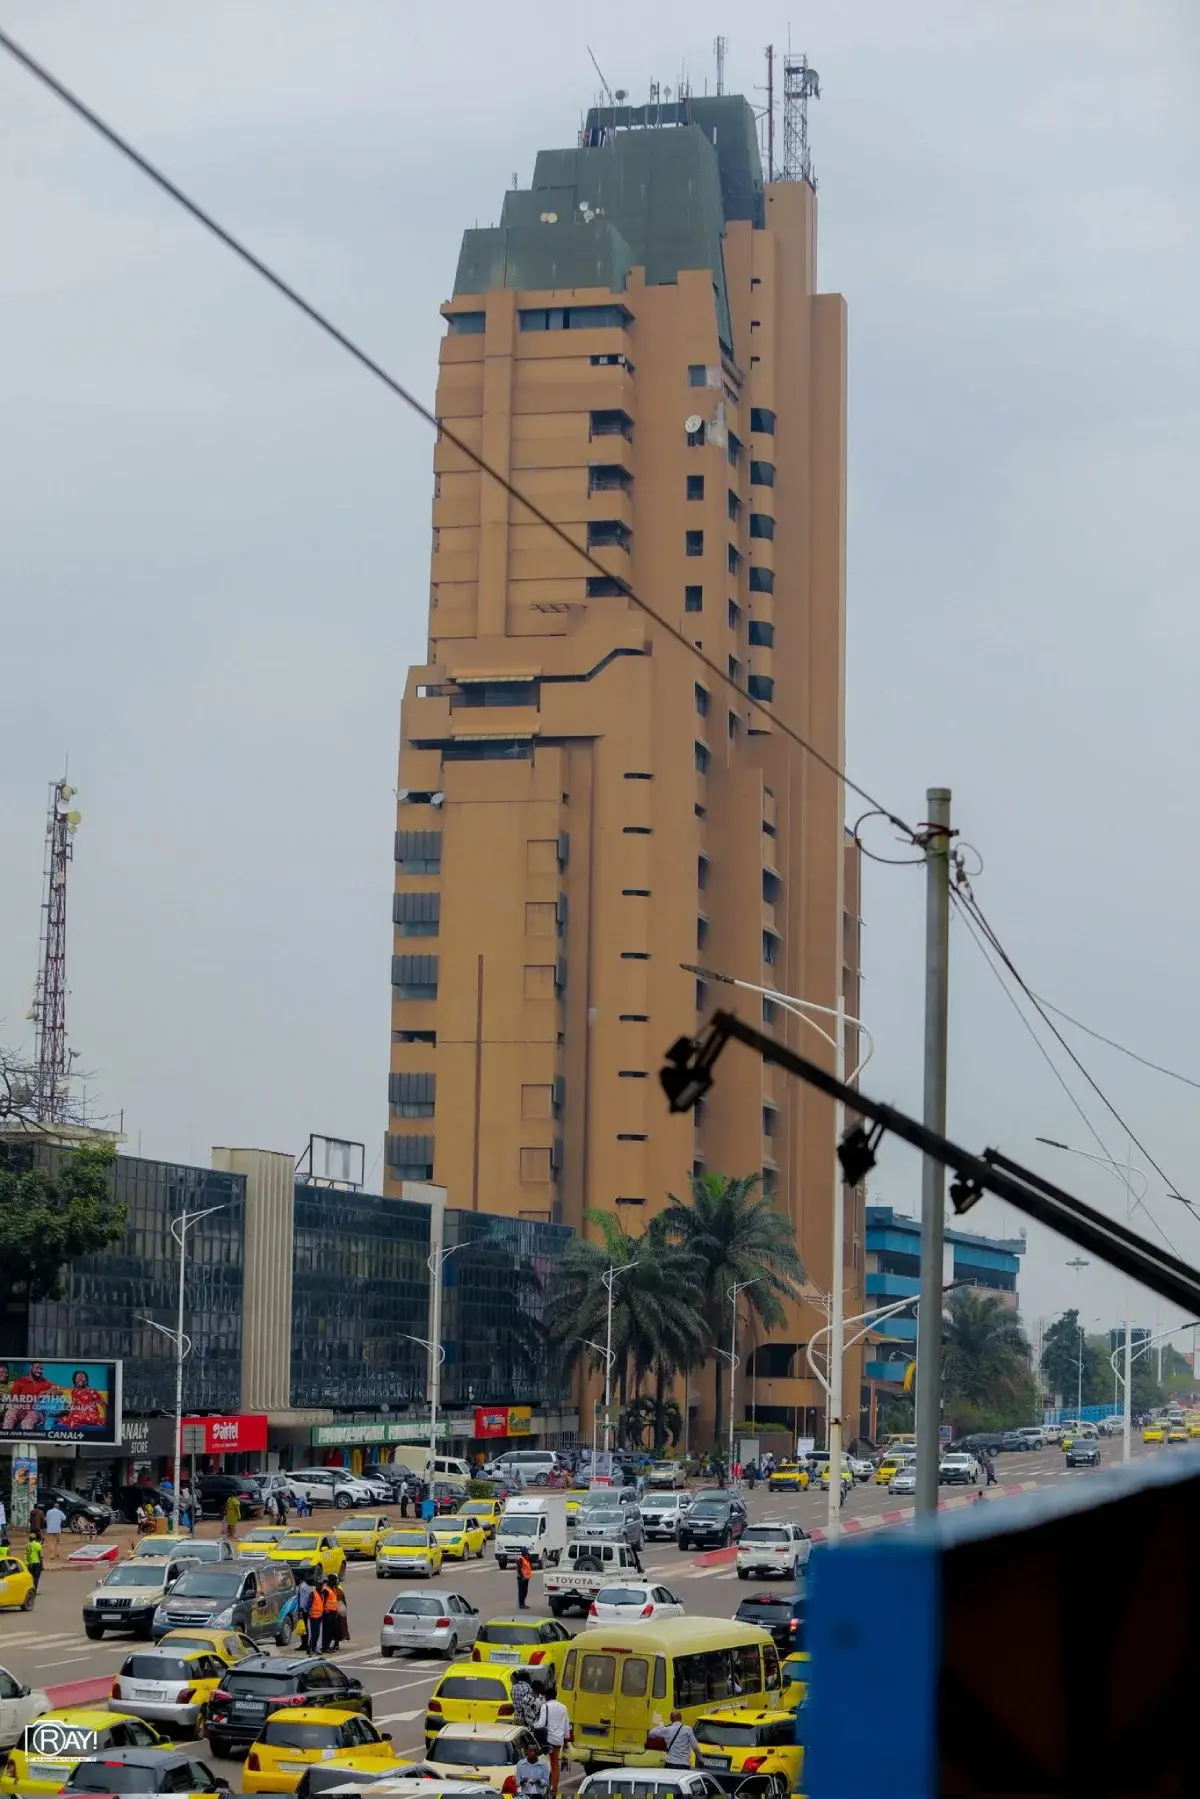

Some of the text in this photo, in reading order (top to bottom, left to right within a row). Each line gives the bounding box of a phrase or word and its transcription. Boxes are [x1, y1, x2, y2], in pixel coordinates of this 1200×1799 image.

[2, 1394, 37, 1403] MARDI
[47, 1431, 85, 1439] CANAL+
[121, 1422, 149, 1440] ANAL+
[219, 1421, 239, 1440] airtel
[131, 1441, 149, 1454] STORE
[555, 1576, 593, 1585] TOYOTA
